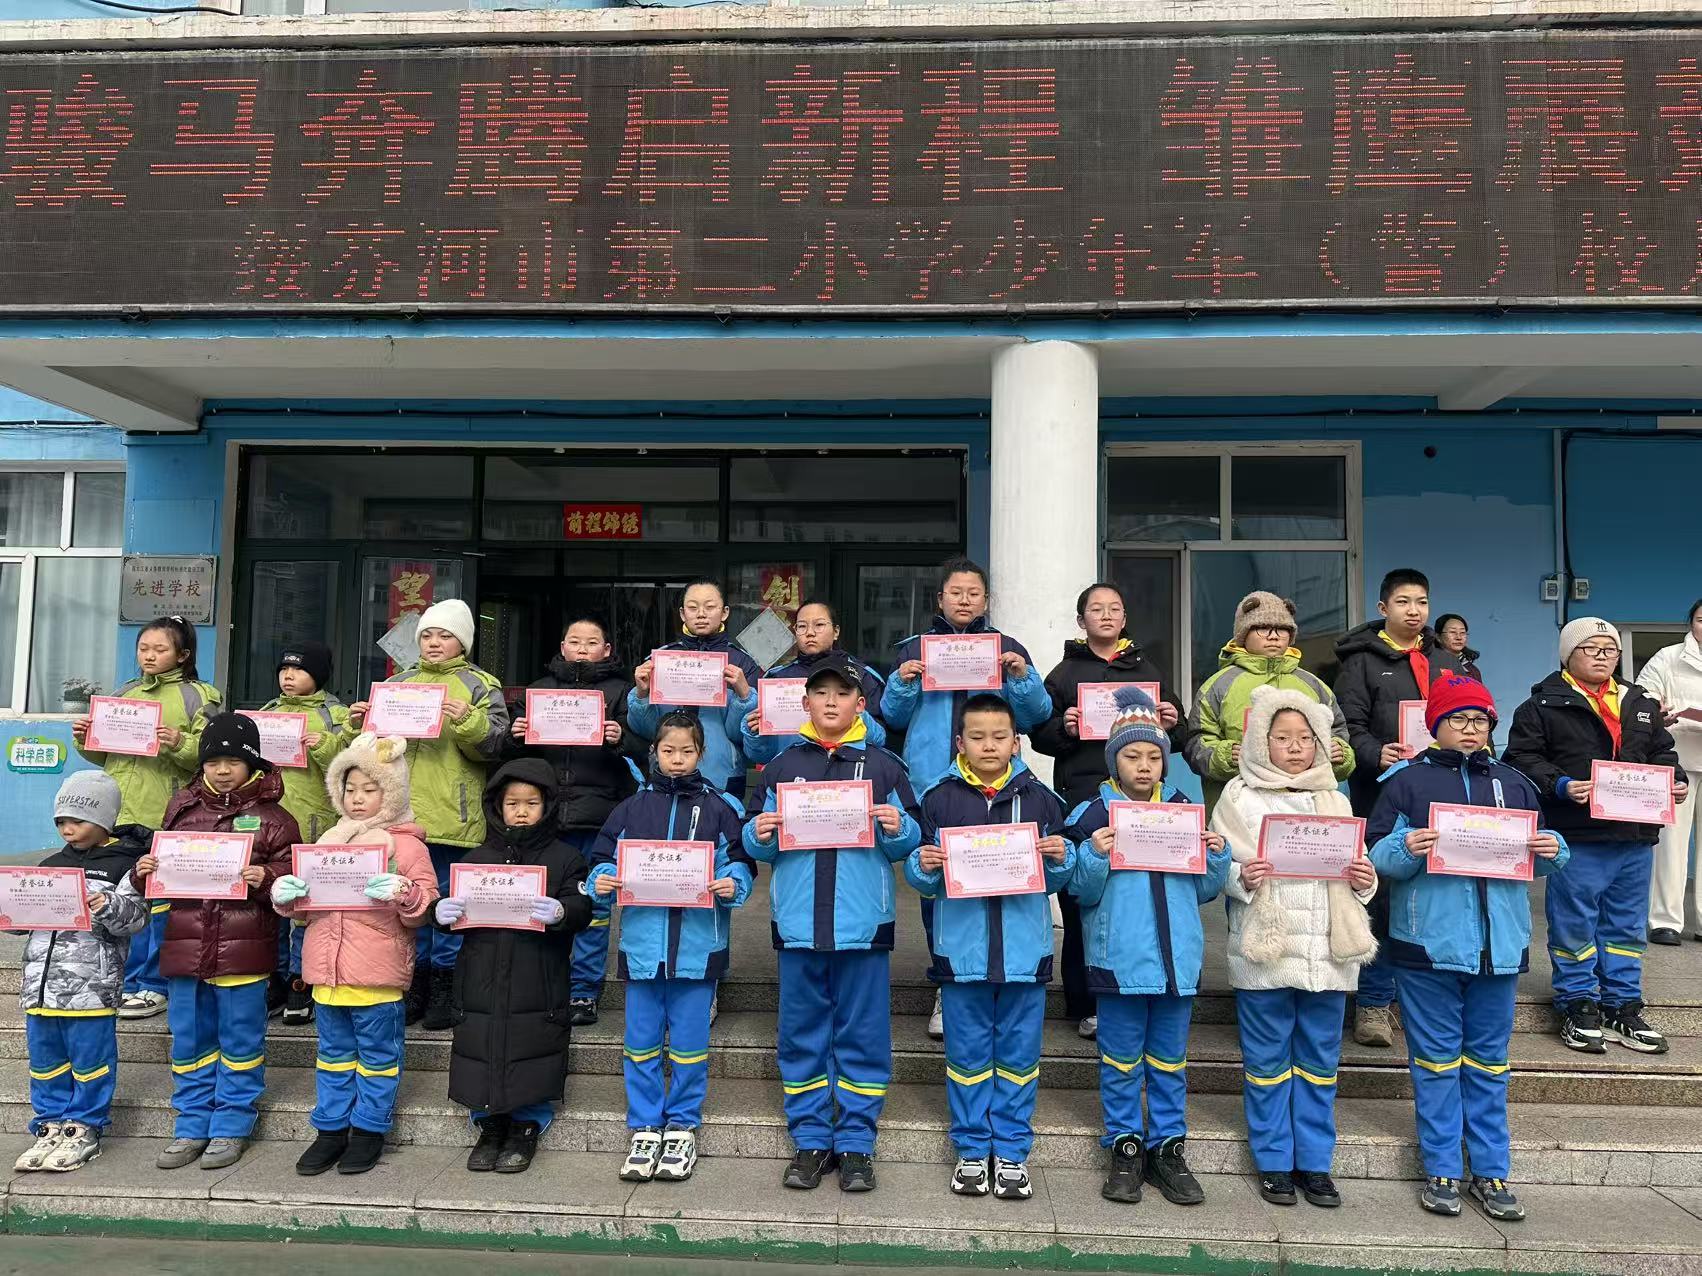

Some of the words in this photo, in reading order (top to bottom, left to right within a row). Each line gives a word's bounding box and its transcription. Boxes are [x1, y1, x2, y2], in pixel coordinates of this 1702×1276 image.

[567, 511, 639, 535] 前程锦绣
[132, 578, 201, 598] 先进学校
[15, 747, 56, 764] 科学启蒙
[57, 795, 101, 809] SUPERSTAR
[1291, 825, 1331, 837] 荣誉证书
[321, 855, 356, 866] 荣誉证书
[647, 852, 683, 863] 荣誉证书
[19, 878, 55, 888] 荣誉证书
[480, 876, 516, 887] 荣誉证书
